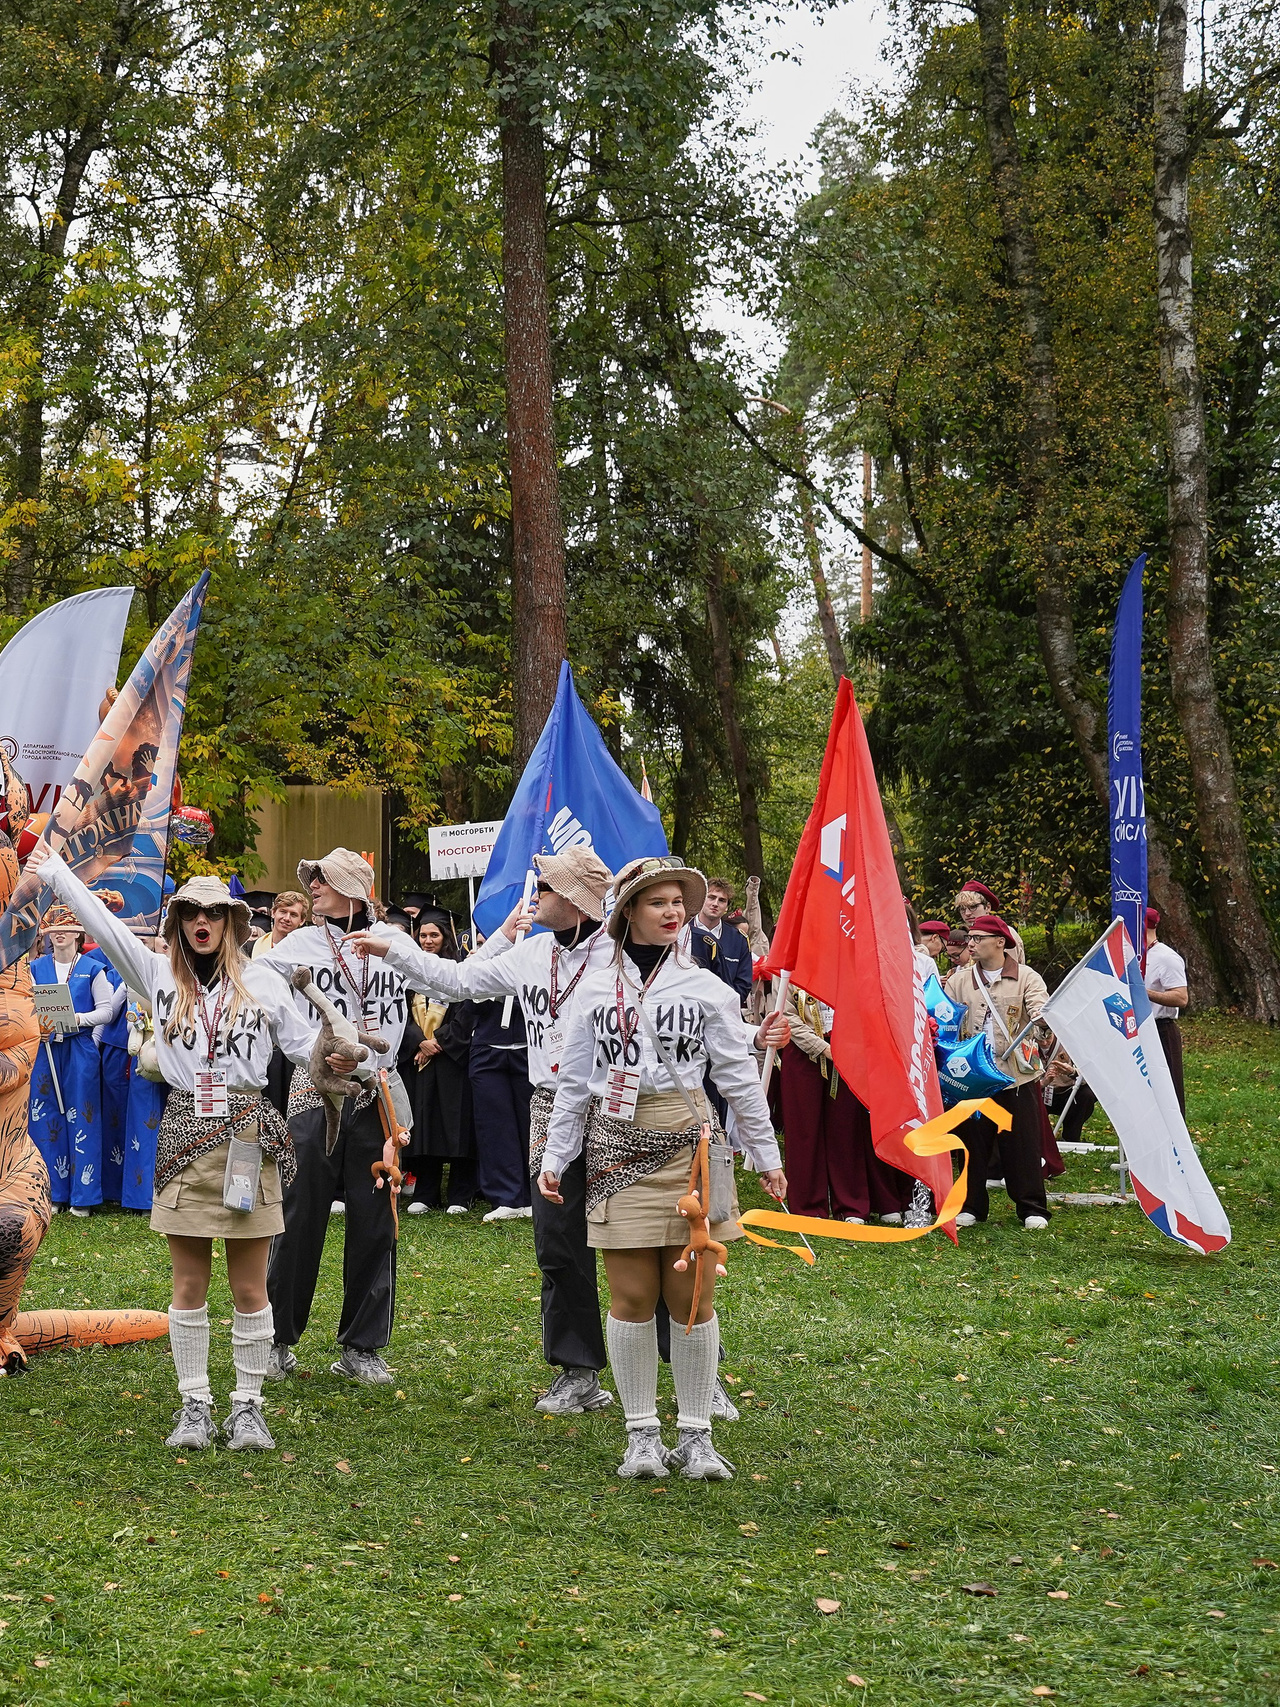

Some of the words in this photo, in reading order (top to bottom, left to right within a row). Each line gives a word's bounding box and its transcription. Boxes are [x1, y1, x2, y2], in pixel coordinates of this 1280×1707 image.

[22, 749, 70, 757] ГРАДОСТРОИТЕЛЬНОЙ
[449, 826, 494, 837] МОСГОРБТИ
[437, 844, 495, 857] МОСГОРБТ
